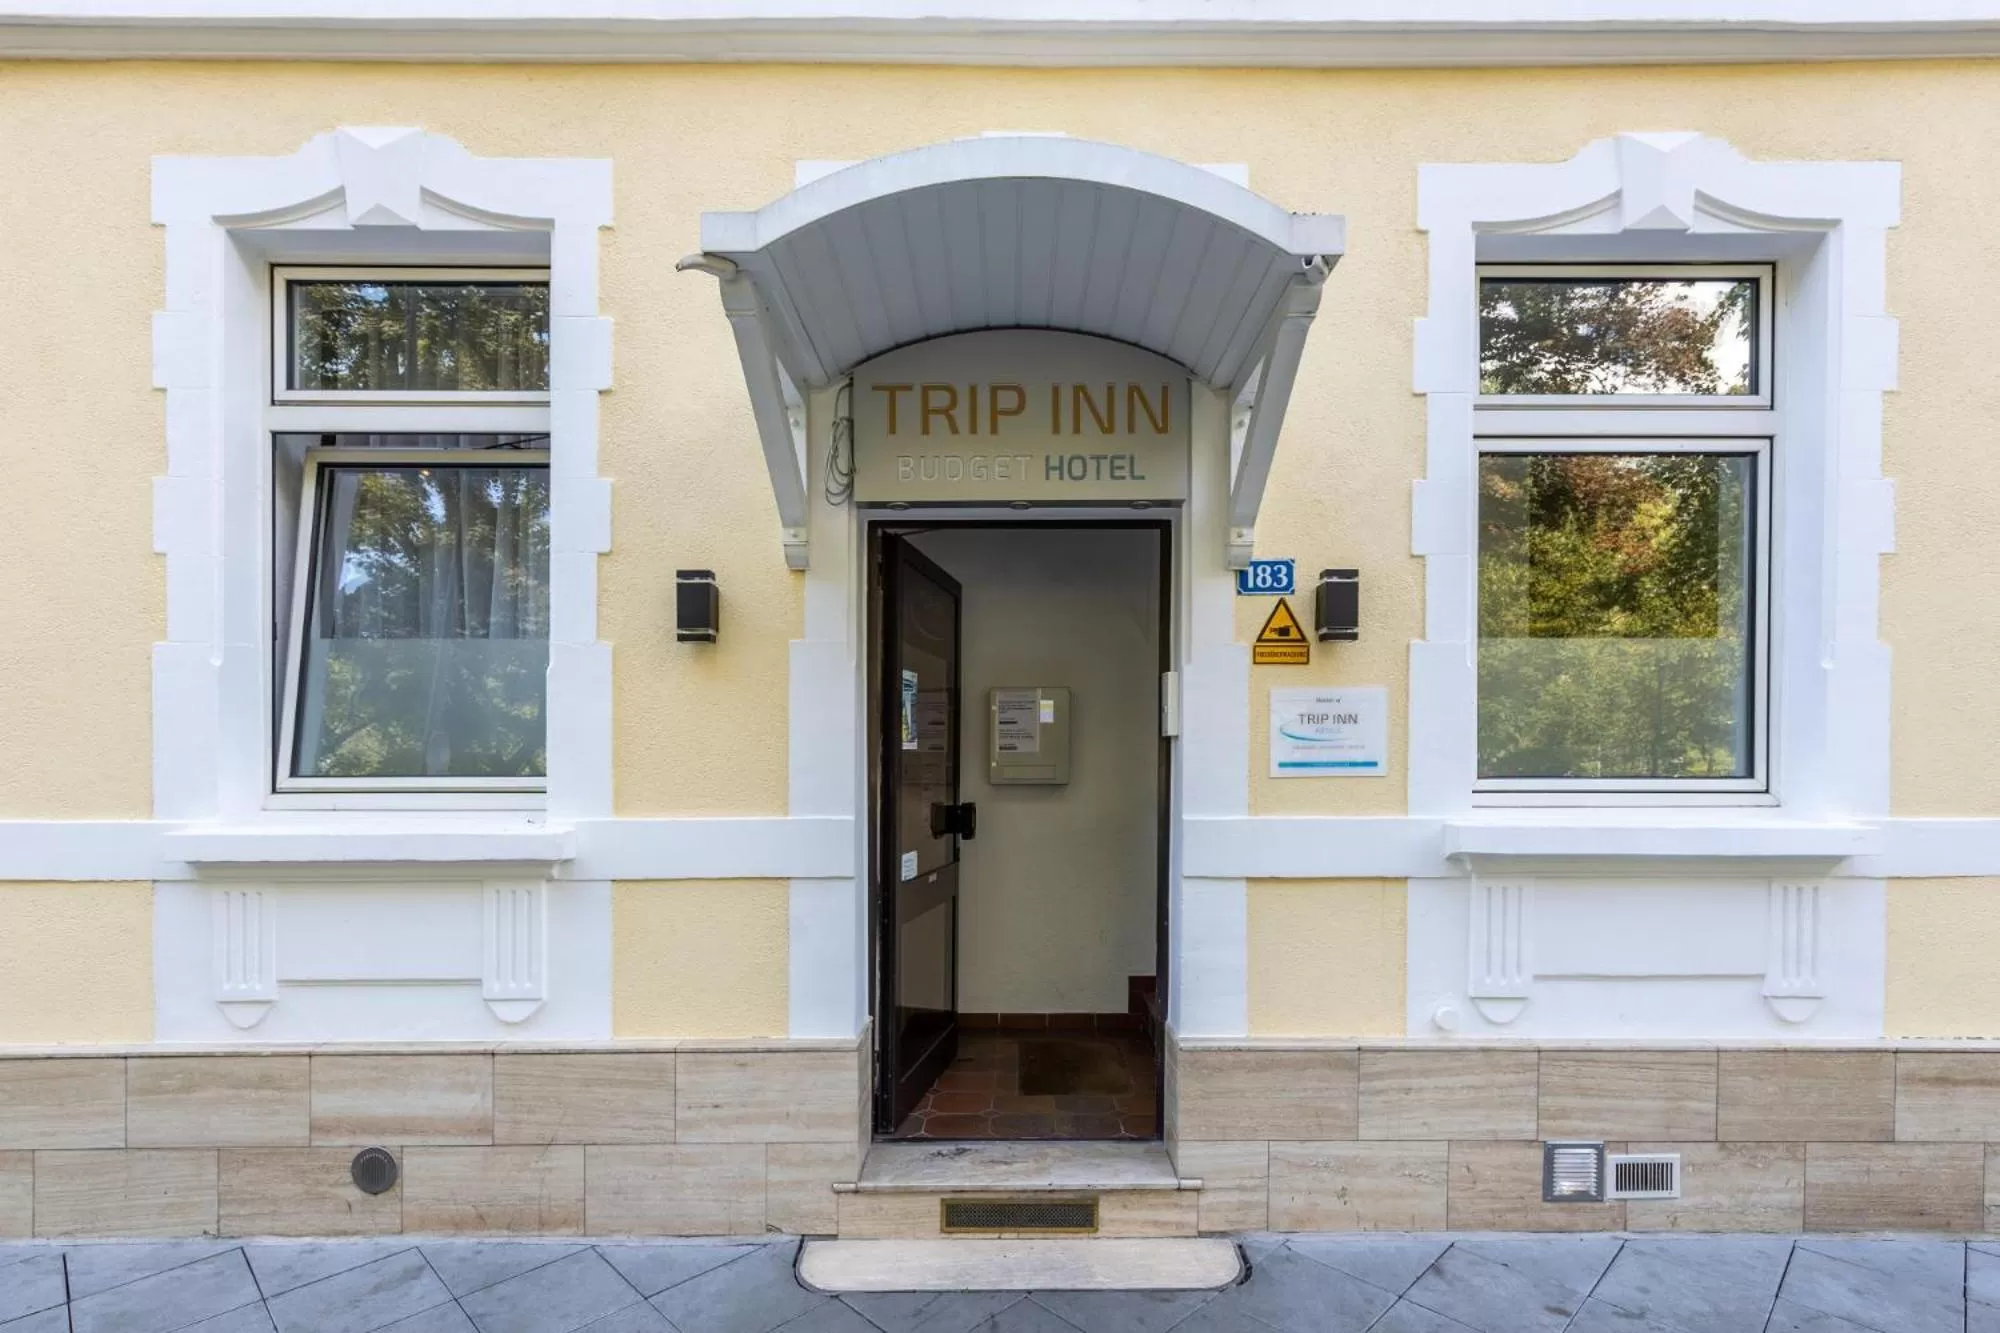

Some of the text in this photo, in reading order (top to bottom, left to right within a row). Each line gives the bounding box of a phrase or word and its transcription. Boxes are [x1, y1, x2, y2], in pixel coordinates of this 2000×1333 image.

[871, 384, 1170, 435] TRIP INN
[896, 455, 1146, 481] BUDGET HOTEL
[1248, 564, 1288, 588] 183
[1297, 713, 1359, 725] TRIP INN
